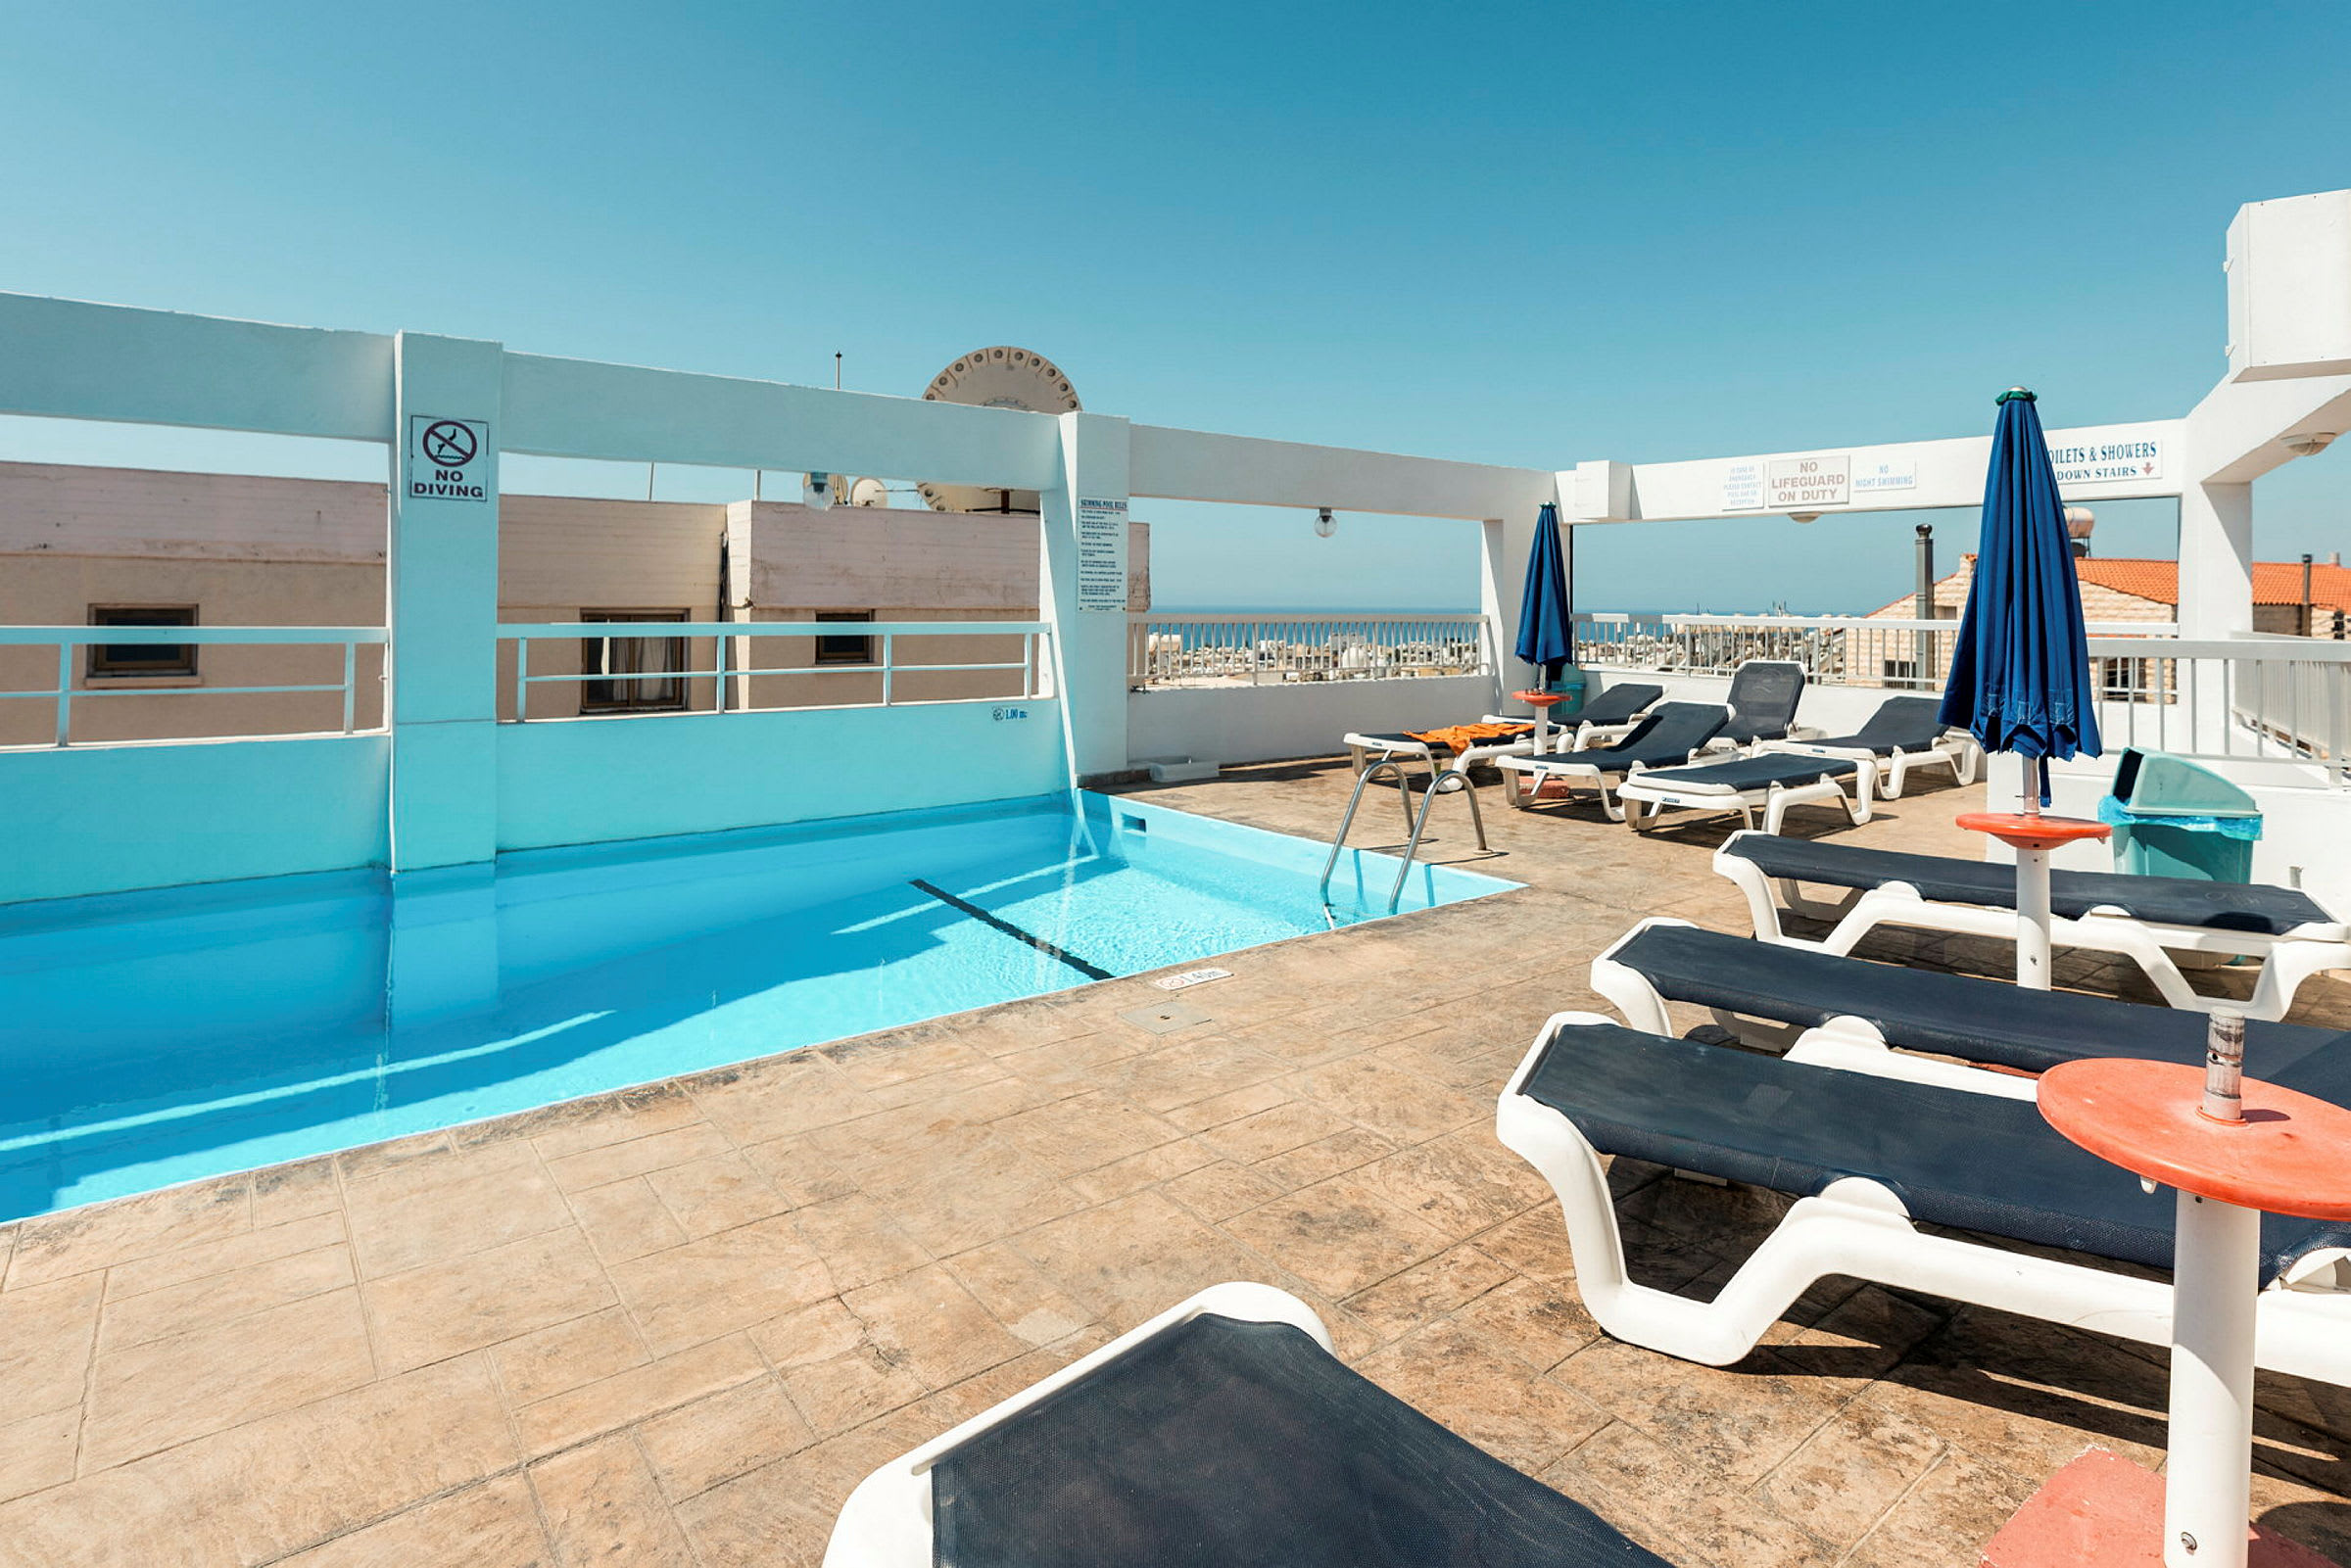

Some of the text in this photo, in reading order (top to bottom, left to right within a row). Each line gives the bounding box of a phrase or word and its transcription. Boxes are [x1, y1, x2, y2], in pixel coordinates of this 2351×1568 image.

[2048, 442, 2157, 464] OILETS & SHOWERS
[1799, 461, 1818, 473] NO
[1879, 463, 1889, 474] NO
[2057, 465, 2137, 481] DOWN STAIRS
[435, 469, 463, 482] NO
[1771, 474, 1845, 490] LIFEGUARD
[1855, 475, 1913, 487] NIGHT SWIMMING
[413, 482, 484, 498] DIVING
[1778, 488, 1838, 501] ON DUTY
